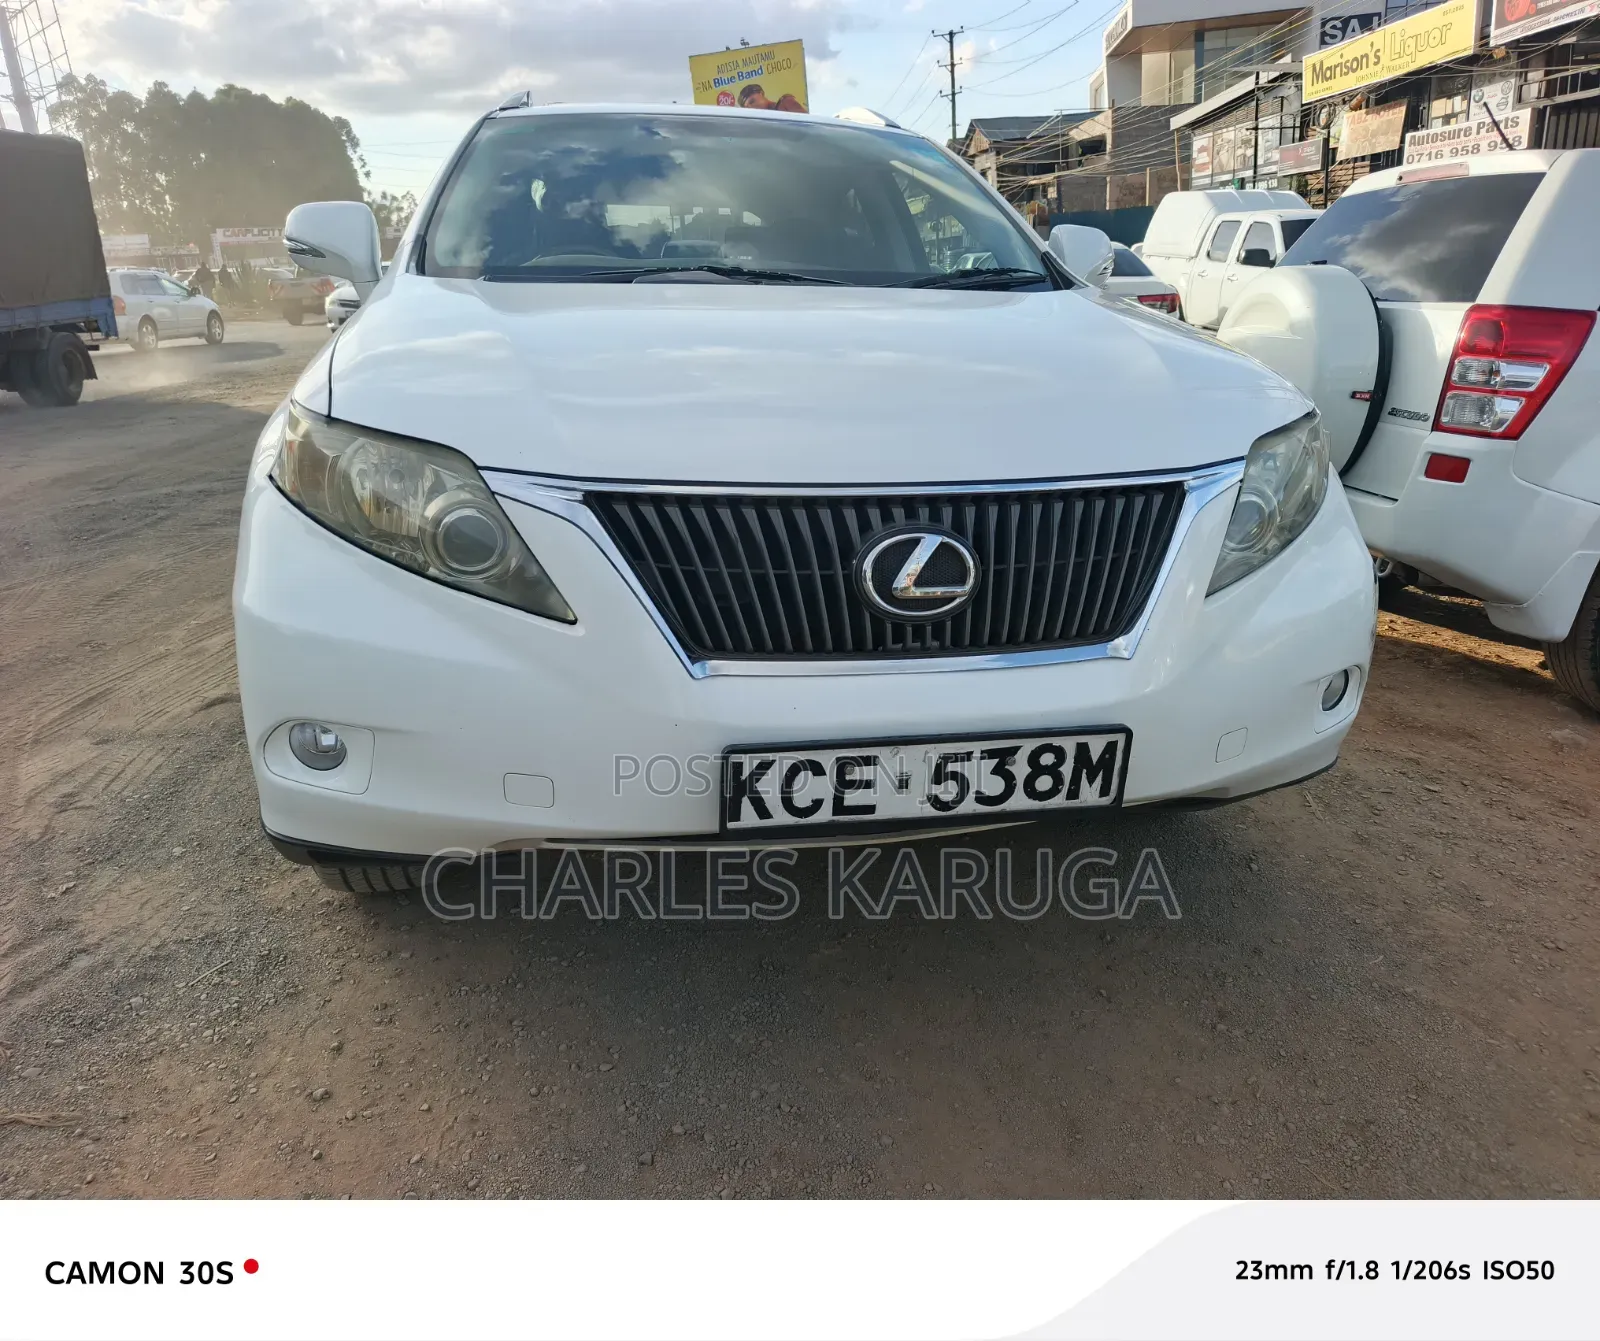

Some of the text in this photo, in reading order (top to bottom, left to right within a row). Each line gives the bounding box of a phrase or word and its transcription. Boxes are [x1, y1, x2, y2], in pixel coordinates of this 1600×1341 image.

[742, 50, 776, 68] MAUTAMU
[1311, 22, 1453, 86] Marison's Liquor
[713, 75, 736, 89] Blue
[737, 65, 764, 82] Band
[766, 58, 792, 75] CHOCO
[1355, 61, 1410, 84] JOHNNIE WALKER
[1408, 126, 1473, 147] Autosure
[1476, 115, 1520, 135] Parts
[1406, 150, 1444, 164] 0716
[1450, 143, 1481, 157] 958
[728, 740, 1119, 823] KCE 538M
